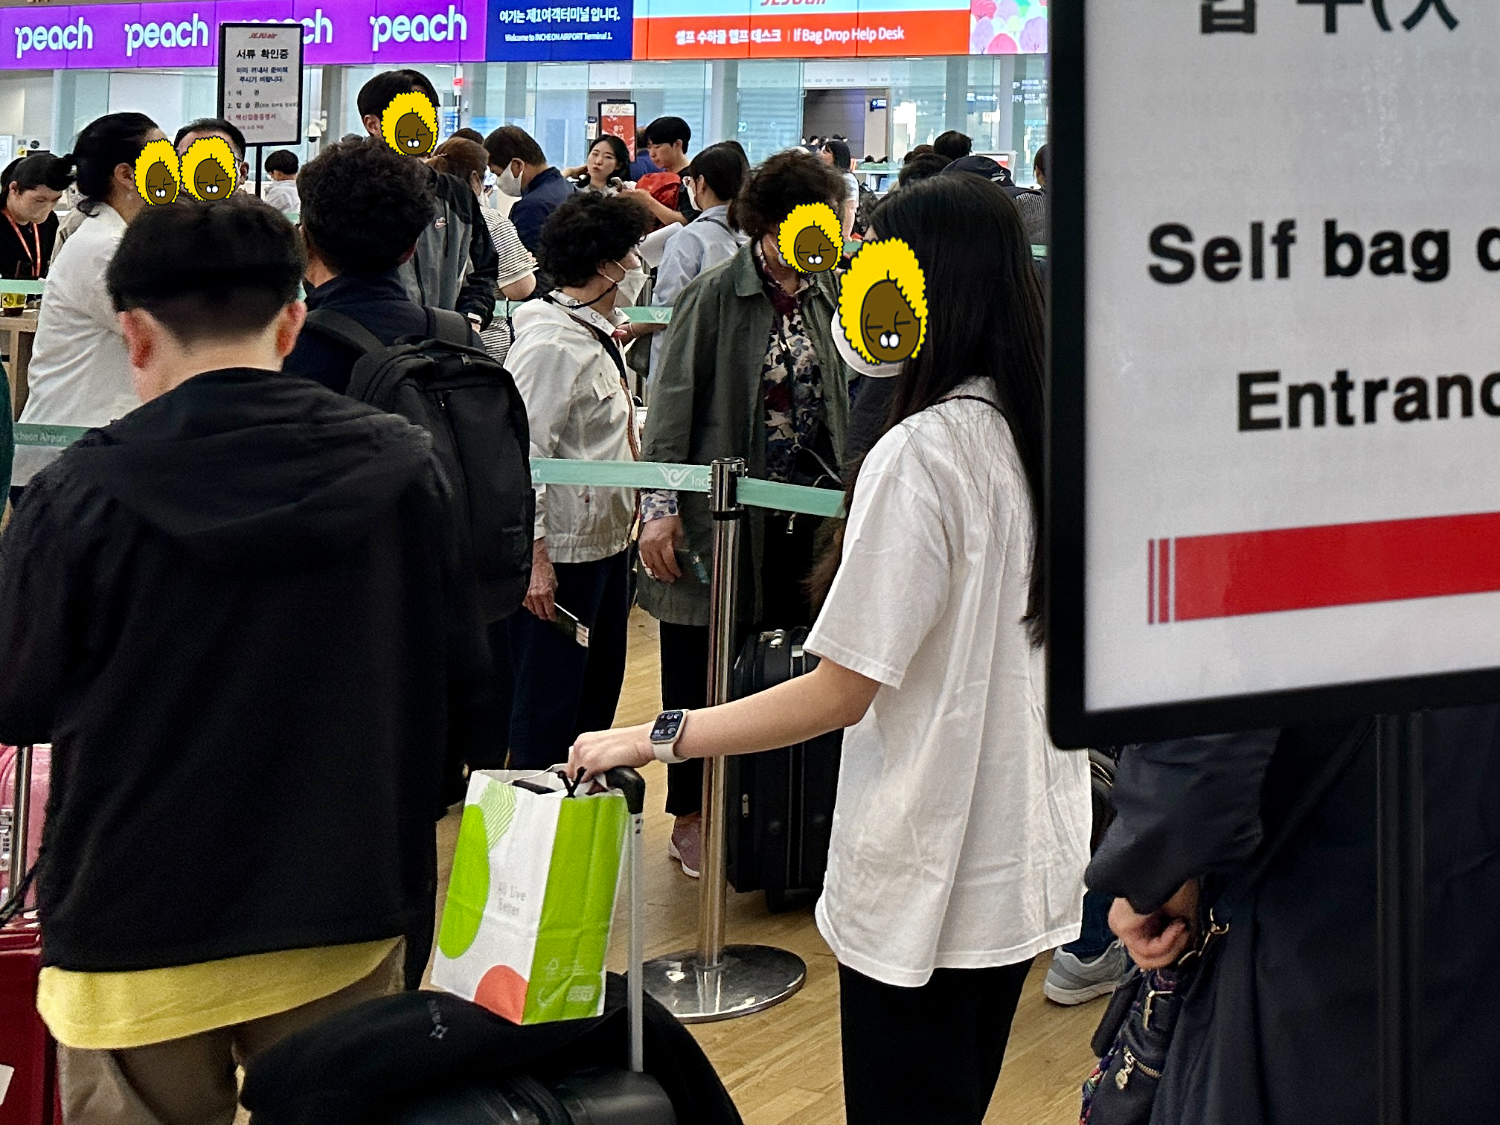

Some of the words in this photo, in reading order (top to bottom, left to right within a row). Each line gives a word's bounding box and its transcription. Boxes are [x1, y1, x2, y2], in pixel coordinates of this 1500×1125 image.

[15, 16, 94, 59] peach
[124, 12, 209, 57] peach
[369, 4, 468, 52] peach
[499, 9, 526, 24] 여기는
[802, 28, 823, 45] Bag
[824, 28, 851, 45] Drop
[851, 26, 877, 44] Help
[878, 25, 905, 41] Desk
[236, 48, 256, 60] 서류
[261, 48, 289, 60] 확인증
[1147, 218, 1297, 285] Self
[1323, 218, 1451, 283] bag
